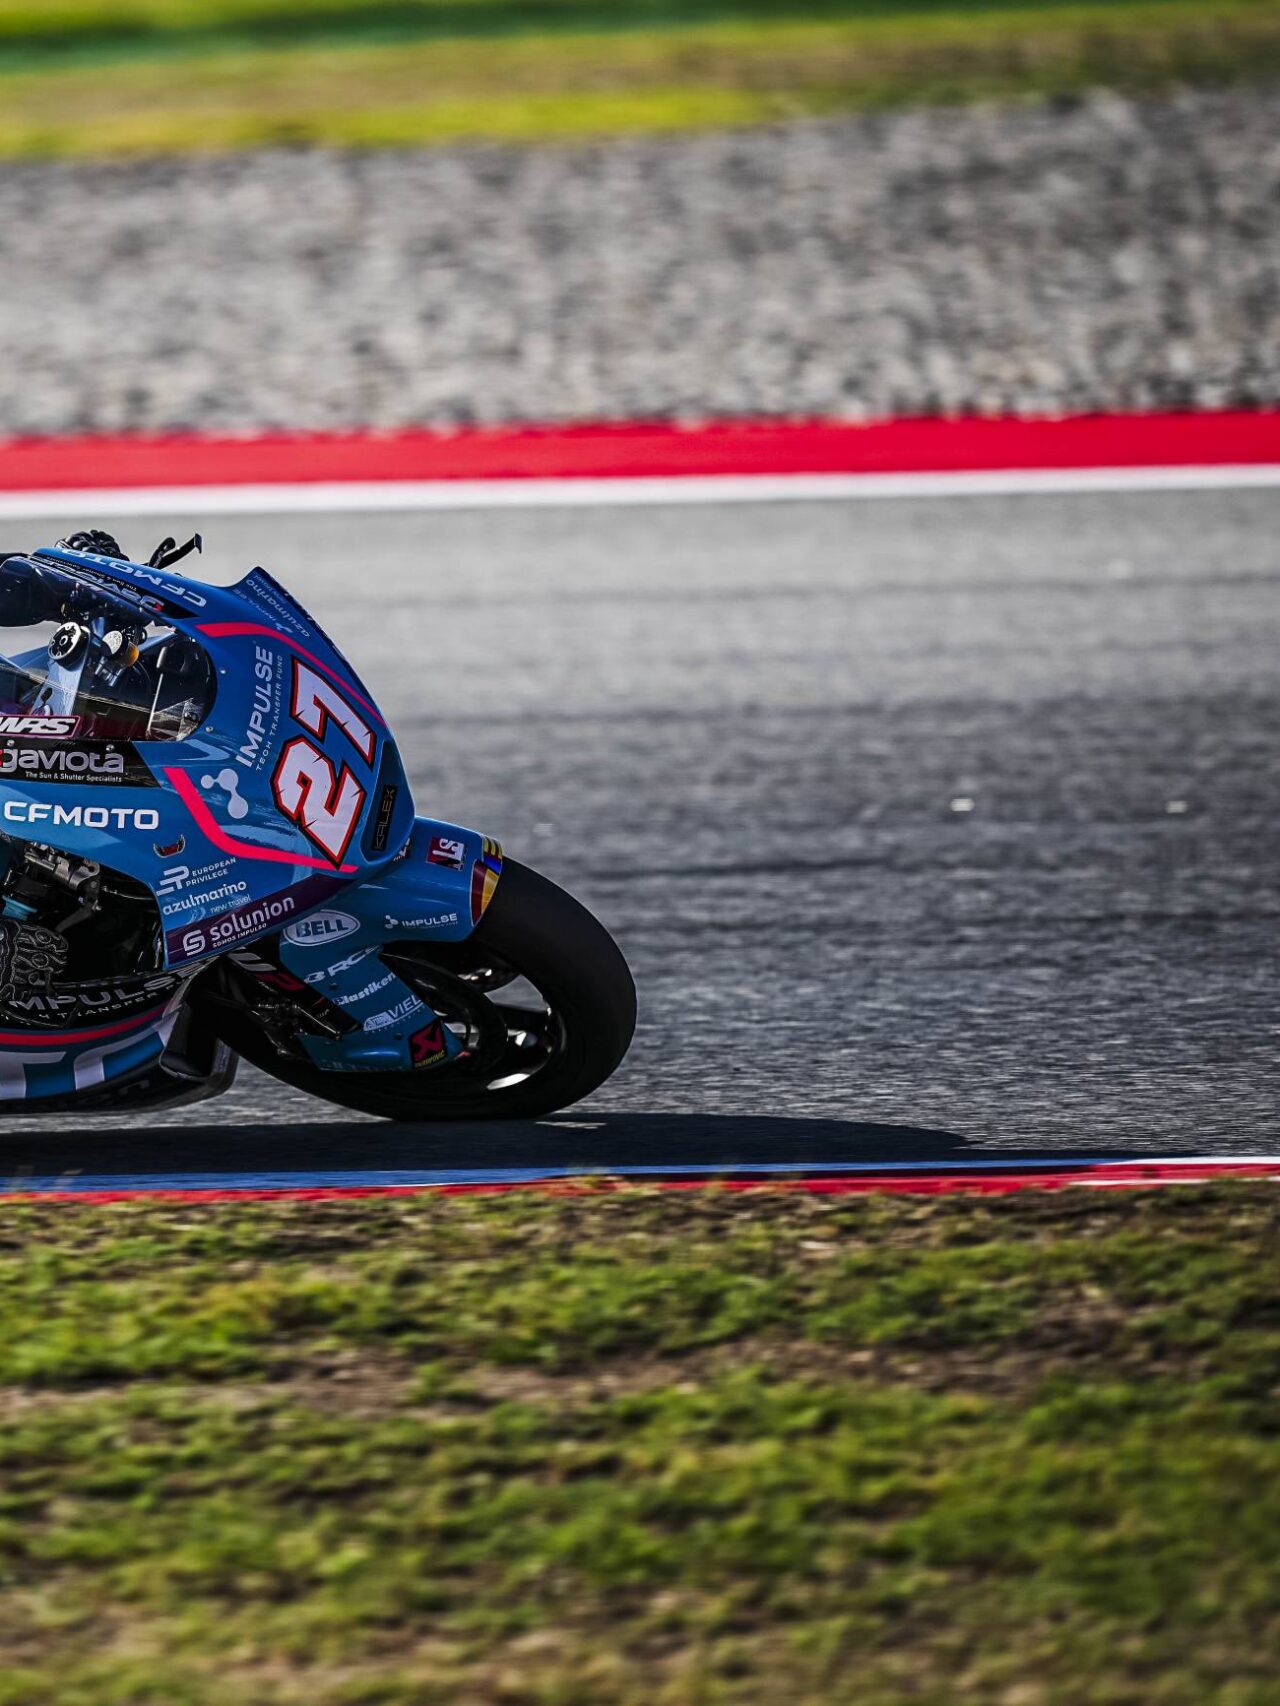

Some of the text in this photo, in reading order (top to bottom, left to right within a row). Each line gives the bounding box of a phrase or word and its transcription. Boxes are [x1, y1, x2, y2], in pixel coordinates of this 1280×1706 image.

[61, 549, 207, 608] CFMOTO
[246, 579, 311, 637] azulmarino
[235, 646, 272, 768] IMPULSE
[256, 740, 271, 772] TECH
[269, 679, 282, 736] TRANSFER
[25, 771, 38, 779] The
[53, 772, 59, 780] &
[60, 773, 84, 781] Shutter
[86, 774, 122, 783] Specialists
[270, 655, 377, 870] 27
[4, 800, 159, 830] CFMOTO
[375, 786, 396, 850] KALEX
[185, 868, 229, 887] PRIVILEGE
[192, 857, 237, 876] EUROPEAN
[162, 881, 247, 915] azulmarino
[210, 894, 251, 914] new travel
[210, 897, 295, 942] solunion
[212, 923, 267, 948] SOMOS IMPULSO
[295, 919, 349, 938] BELL
[402, 913, 458, 927] IMPULSE
